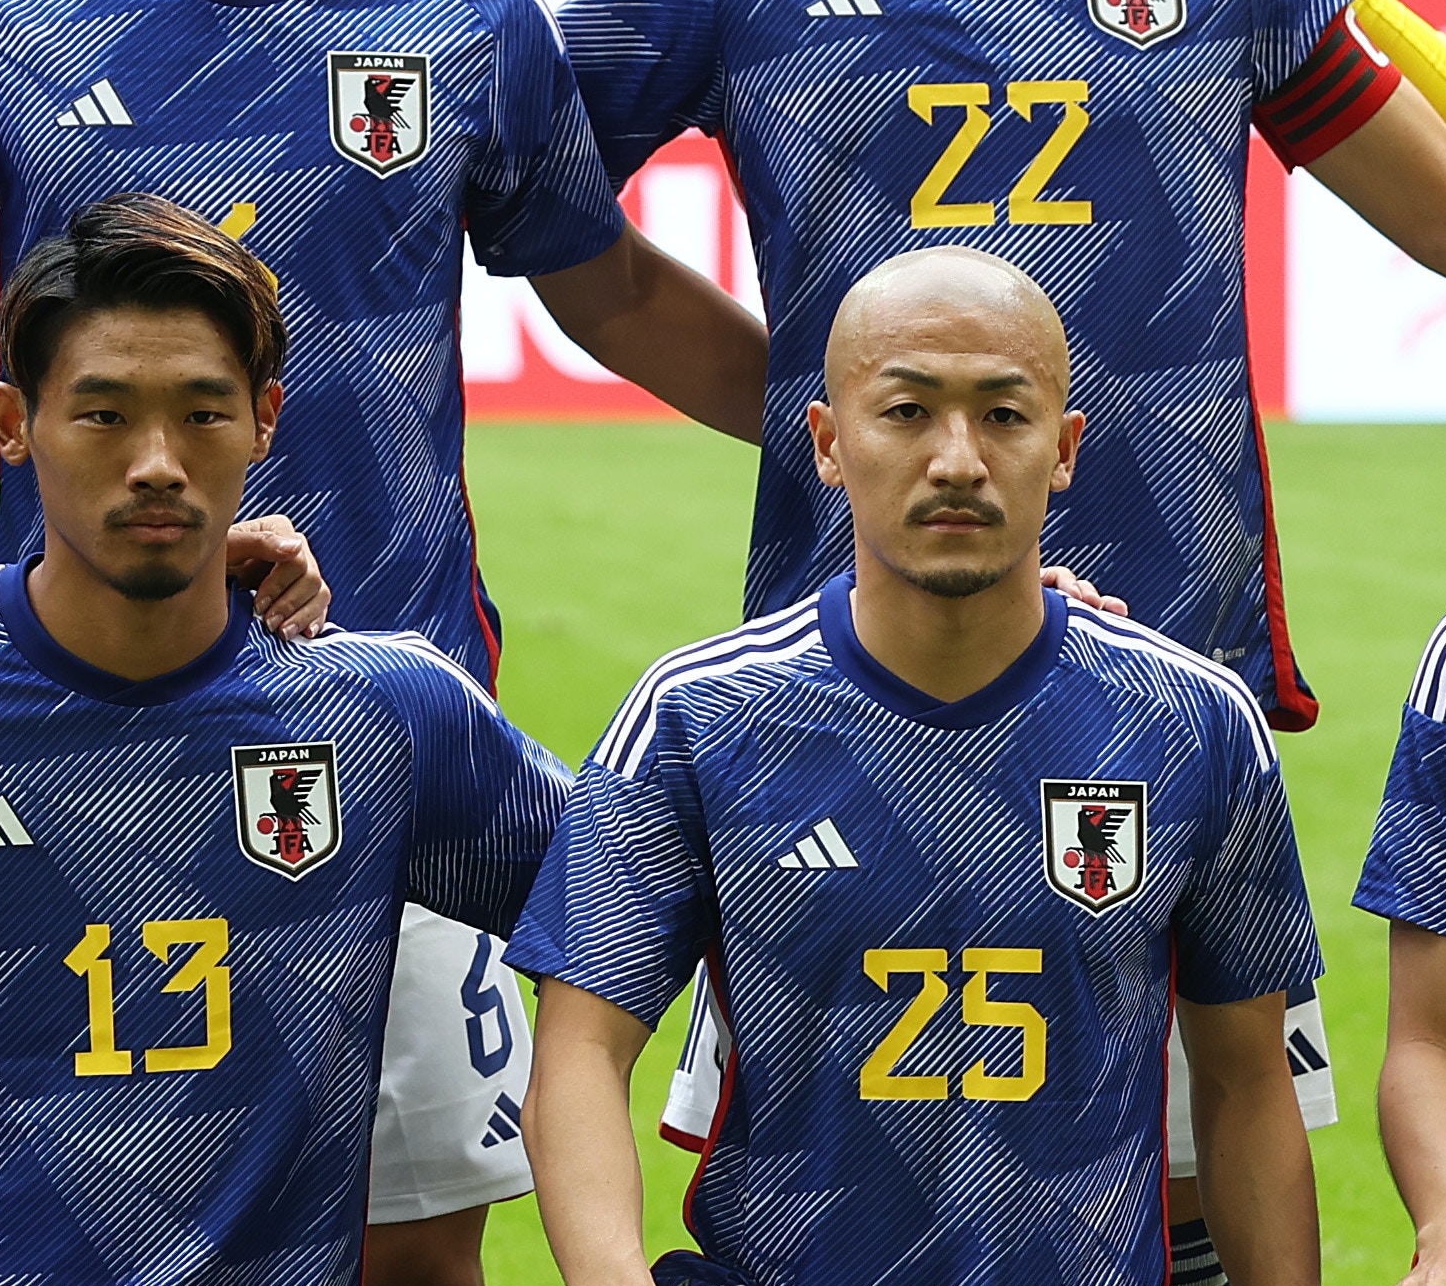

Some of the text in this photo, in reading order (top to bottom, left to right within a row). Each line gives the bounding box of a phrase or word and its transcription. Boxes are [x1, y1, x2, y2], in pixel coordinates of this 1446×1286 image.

[1118, 7, 1157, 27] JFA
[354, 57, 404, 69] JAPAN
[360, 135, 403, 155] JFA
[907, 80, 1093, 229] 22
[258, 749, 311, 763] JAPAN
[1067, 786, 1120, 798] JAPAN
[270, 834, 314, 855] JFA
[1074, 871, 1118, 891] JFA
[63, 917, 233, 1077] 13
[460, 932, 513, 1079] 6
[859, 948, 1048, 1102] 25
